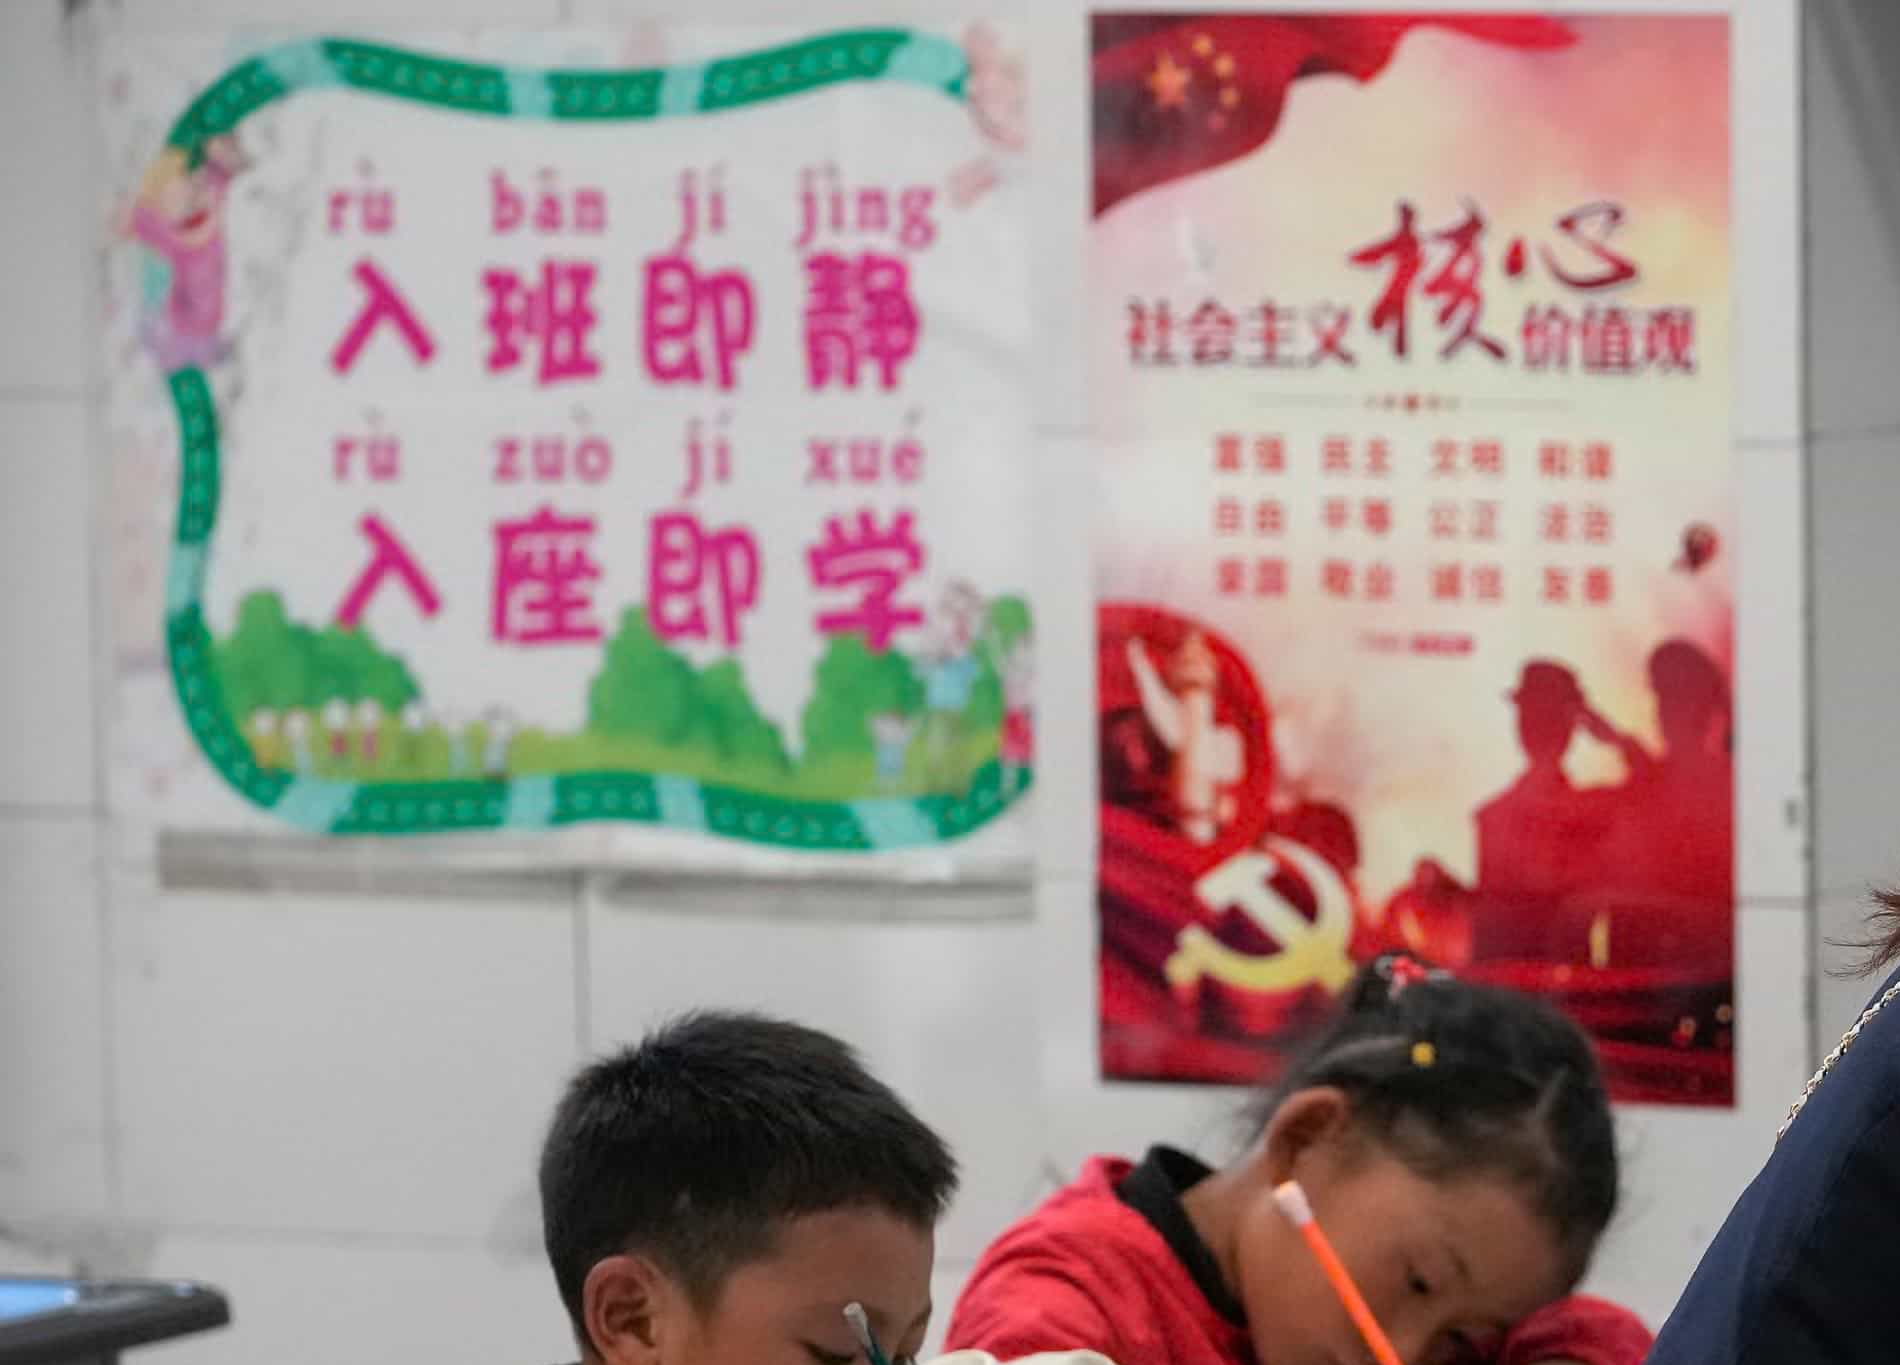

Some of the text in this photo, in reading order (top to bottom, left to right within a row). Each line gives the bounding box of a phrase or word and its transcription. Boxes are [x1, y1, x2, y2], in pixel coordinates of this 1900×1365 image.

[330, 252, 921, 390] 入班即静
[1126, 300, 1356, 367] 社会主义
[1518, 304, 1697, 374] 价值观
[336, 504, 926, 652] 入座即学
